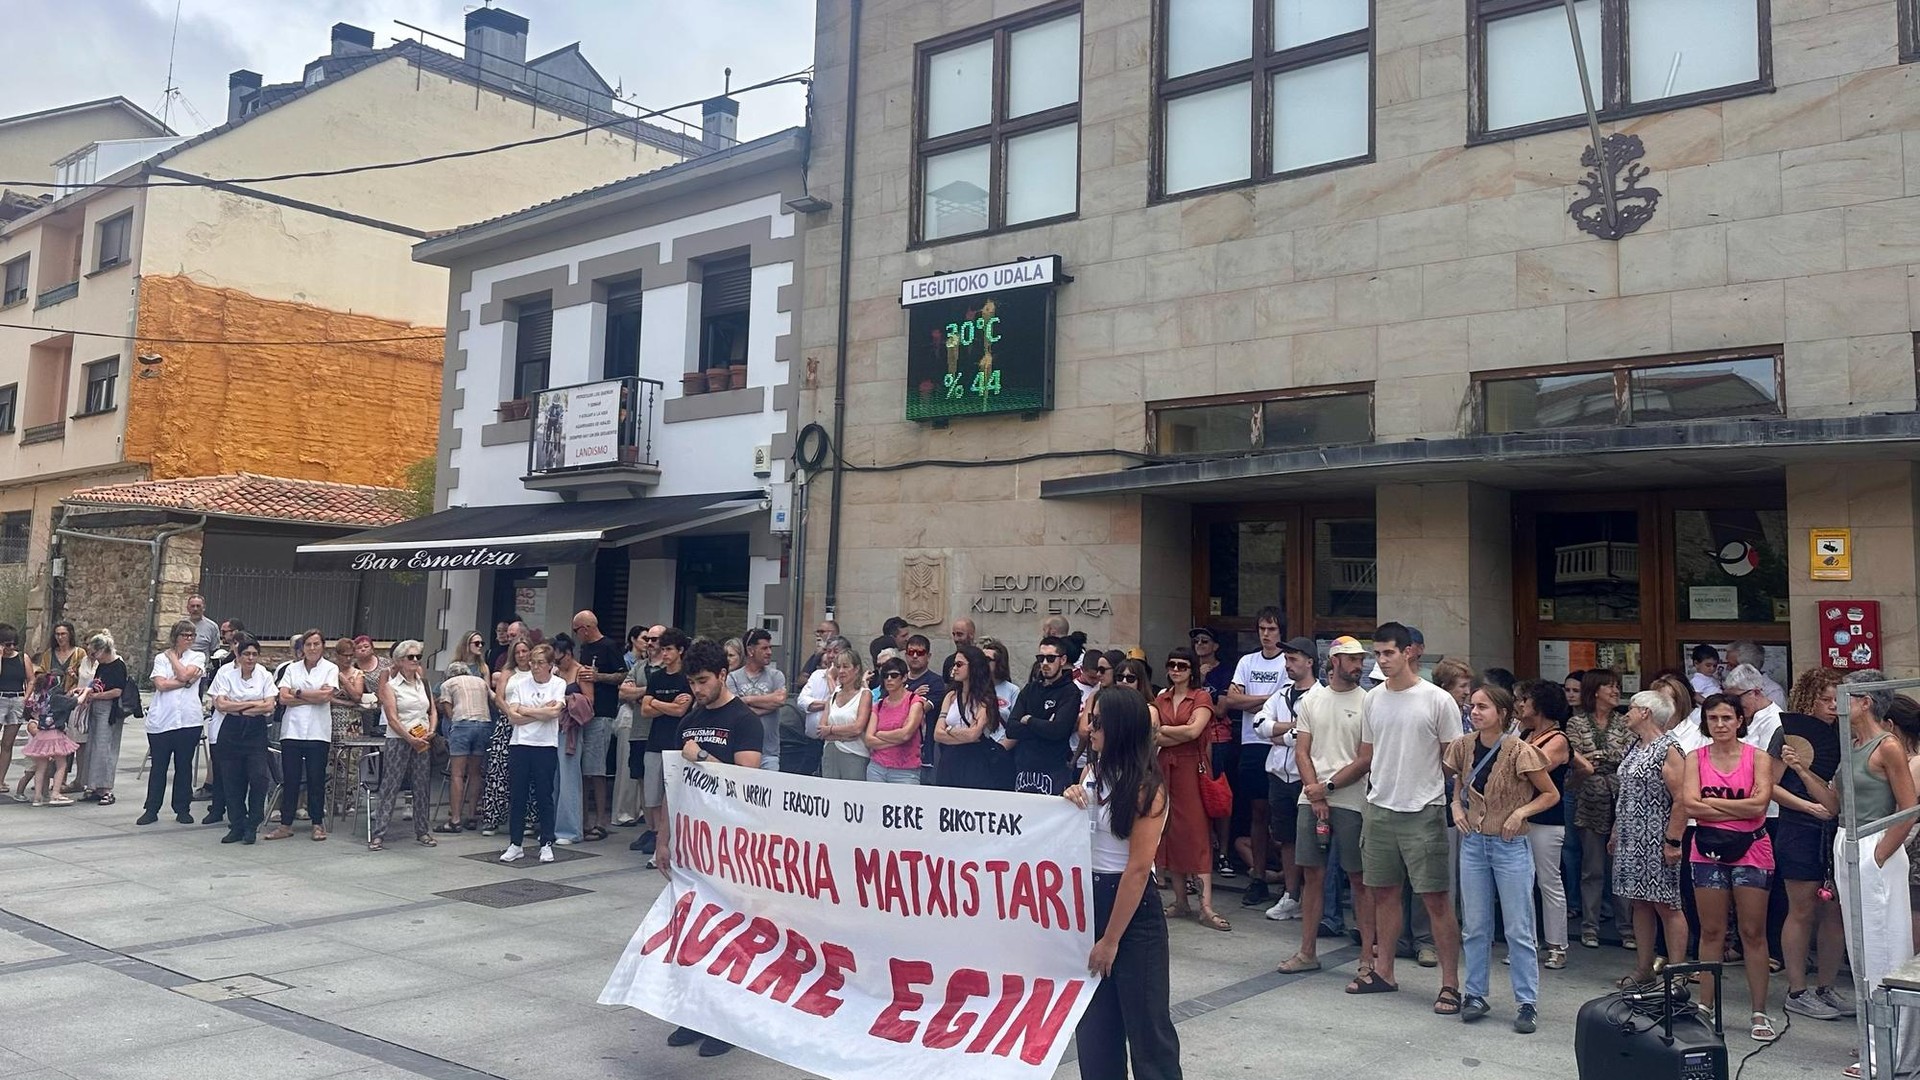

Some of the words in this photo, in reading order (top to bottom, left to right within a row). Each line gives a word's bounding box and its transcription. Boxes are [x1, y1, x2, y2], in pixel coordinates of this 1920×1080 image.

[911, 272, 989, 300] LEGUTIOKO
[994, 263, 1044, 287] UDALA
[945, 316, 1002, 349] 30°C
[943, 371, 965, 400] %
[970, 368, 1002, 396] 44
[575, 444, 609, 459] LANDISMO
[351, 551, 404, 571] Bar
[407, 547, 522, 569] Esneitza
[980, 573, 1085, 592] LEGUTIOKO
[970, 596, 1038, 614] KULTUR
[1048, 597, 1114, 618] ETXEA
[783, 791, 830, 819] ERASOTU
[843, 801, 865, 824] DU
[882, 804, 924, 831] BERE
[939, 807, 1023, 836] BIKOTEAK
[675, 811, 840, 905] INDARKERIA
[854, 847, 1087, 933] MATXISTARI
[641, 890, 858, 1019] AURRE
[868, 957, 1086, 1067] EGIN
